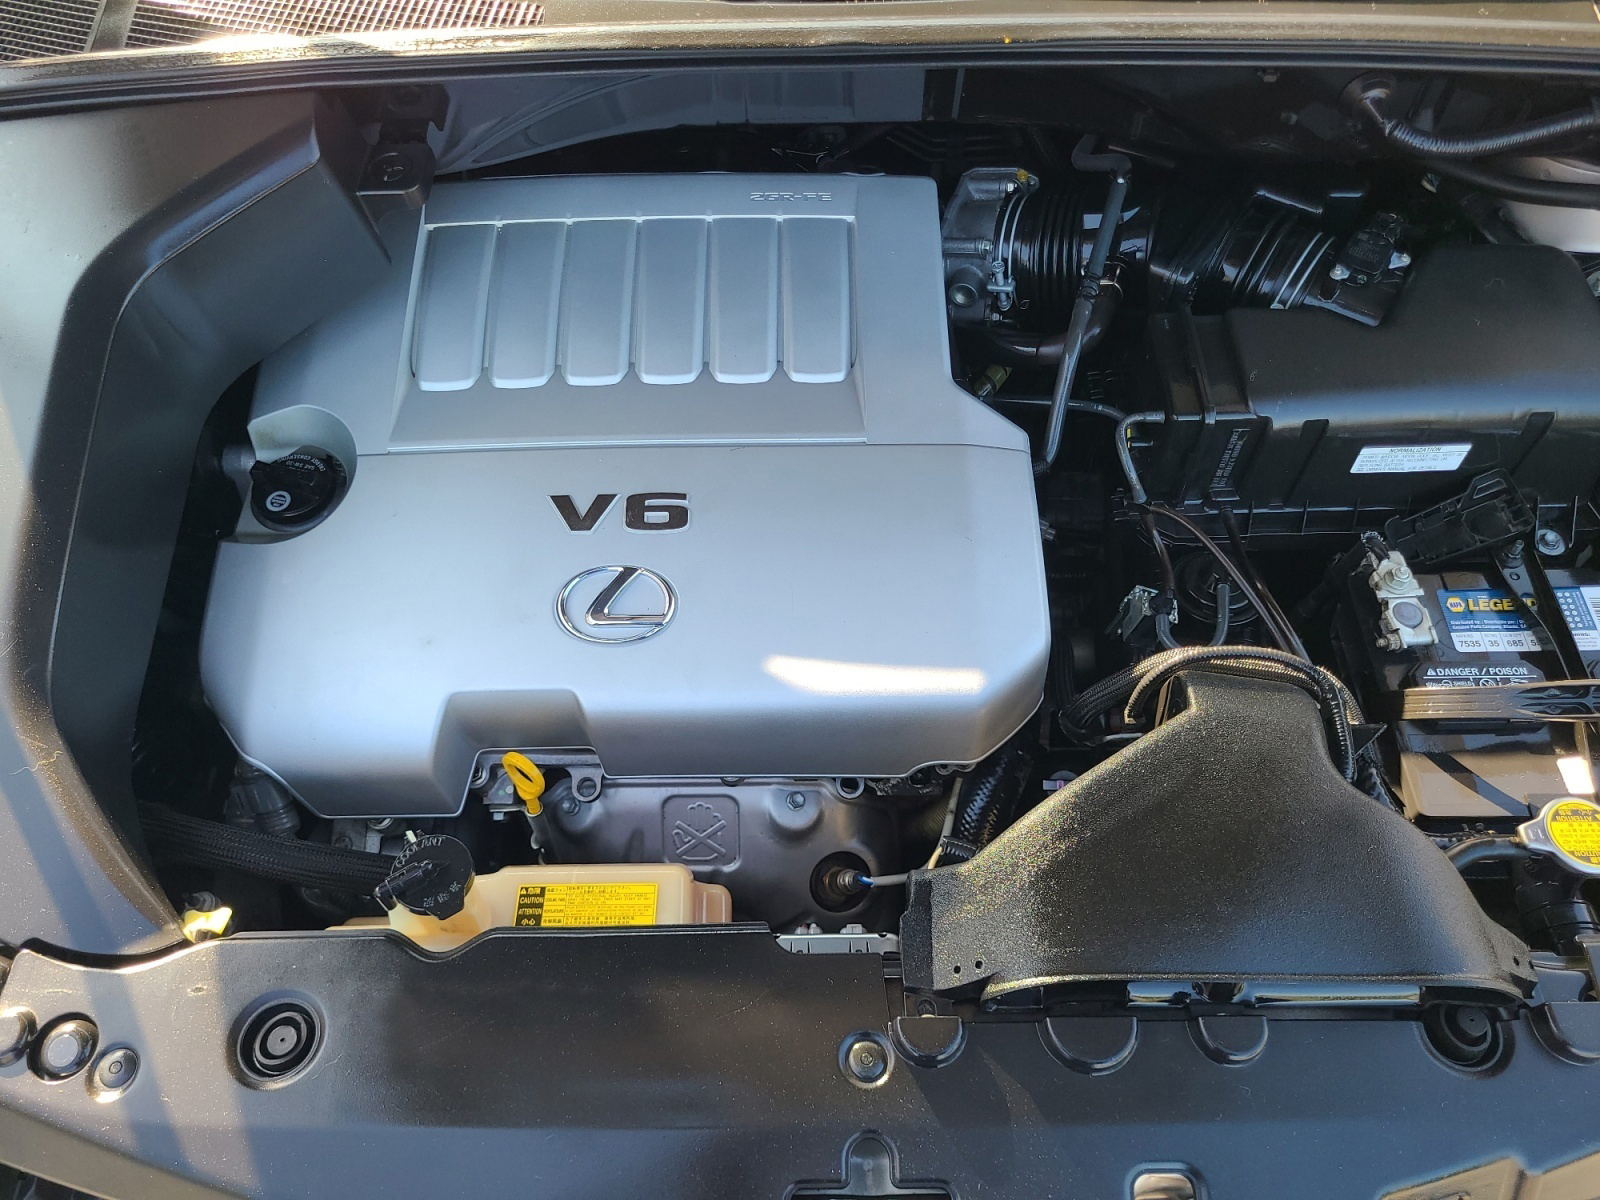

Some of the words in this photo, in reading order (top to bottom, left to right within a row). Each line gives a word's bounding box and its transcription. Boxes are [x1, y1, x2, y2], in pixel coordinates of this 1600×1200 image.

[750, 192, 832, 201] 2GR-FE
[546, 492, 690, 535] V6
[1458, 640, 1481, 648] 7535
[1436, 668, 1480, 676] DANGER
[1490, 667, 1528, 675] POISON
[395, 837, 446, 868] COOLANT
[519, 896, 544, 904] CAUTION
